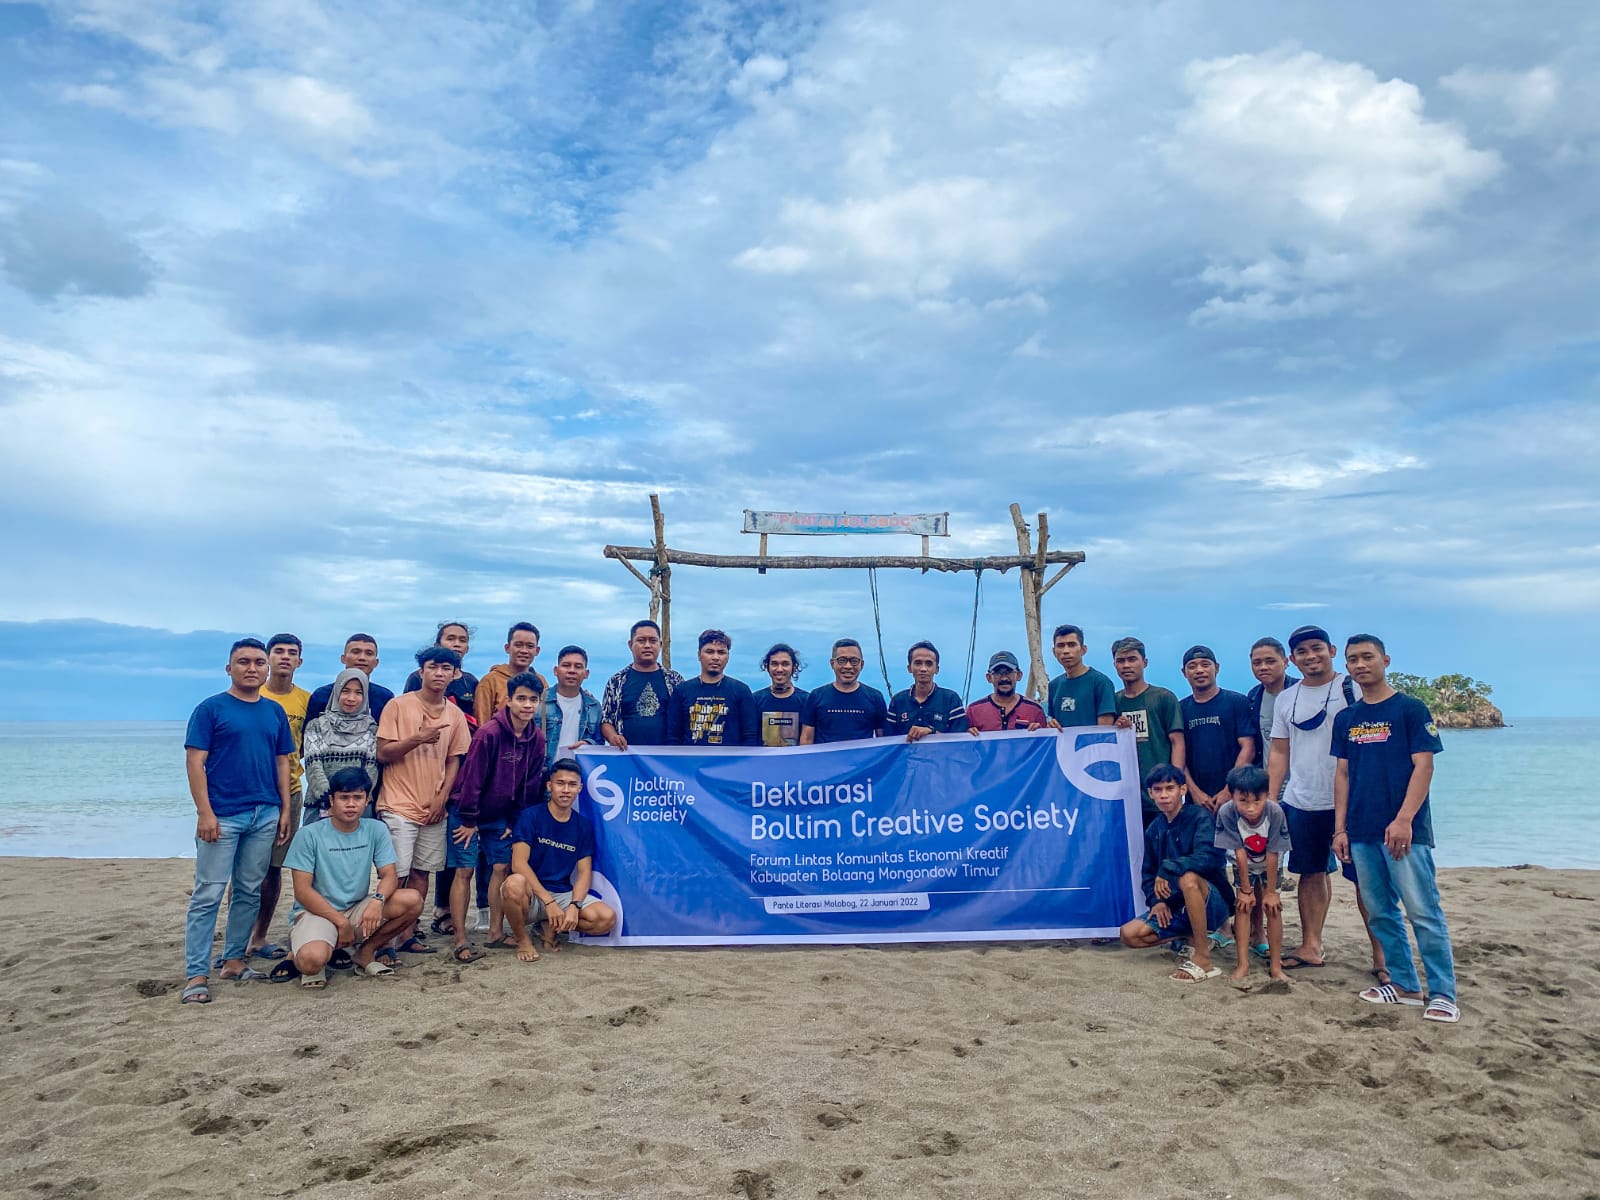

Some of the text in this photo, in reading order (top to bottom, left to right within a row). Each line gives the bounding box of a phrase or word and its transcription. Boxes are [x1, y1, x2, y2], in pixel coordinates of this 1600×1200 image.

[634, 776, 685, 792] boltim
[751, 778, 873, 808] Deklarasi
[633, 792, 695, 806] creative
[632, 806, 688, 825] society
[751, 801, 1079, 840] Boltim Creative Society
[750, 845, 1009, 867] Forum Lintas Komunitas Ekonomi Kreatif
[750, 863, 1000, 885] Kabupaten Bolaang Mongondow Timur
[772, 896, 919, 910] Pante Literasi Molobog, 22 Januari 2022
